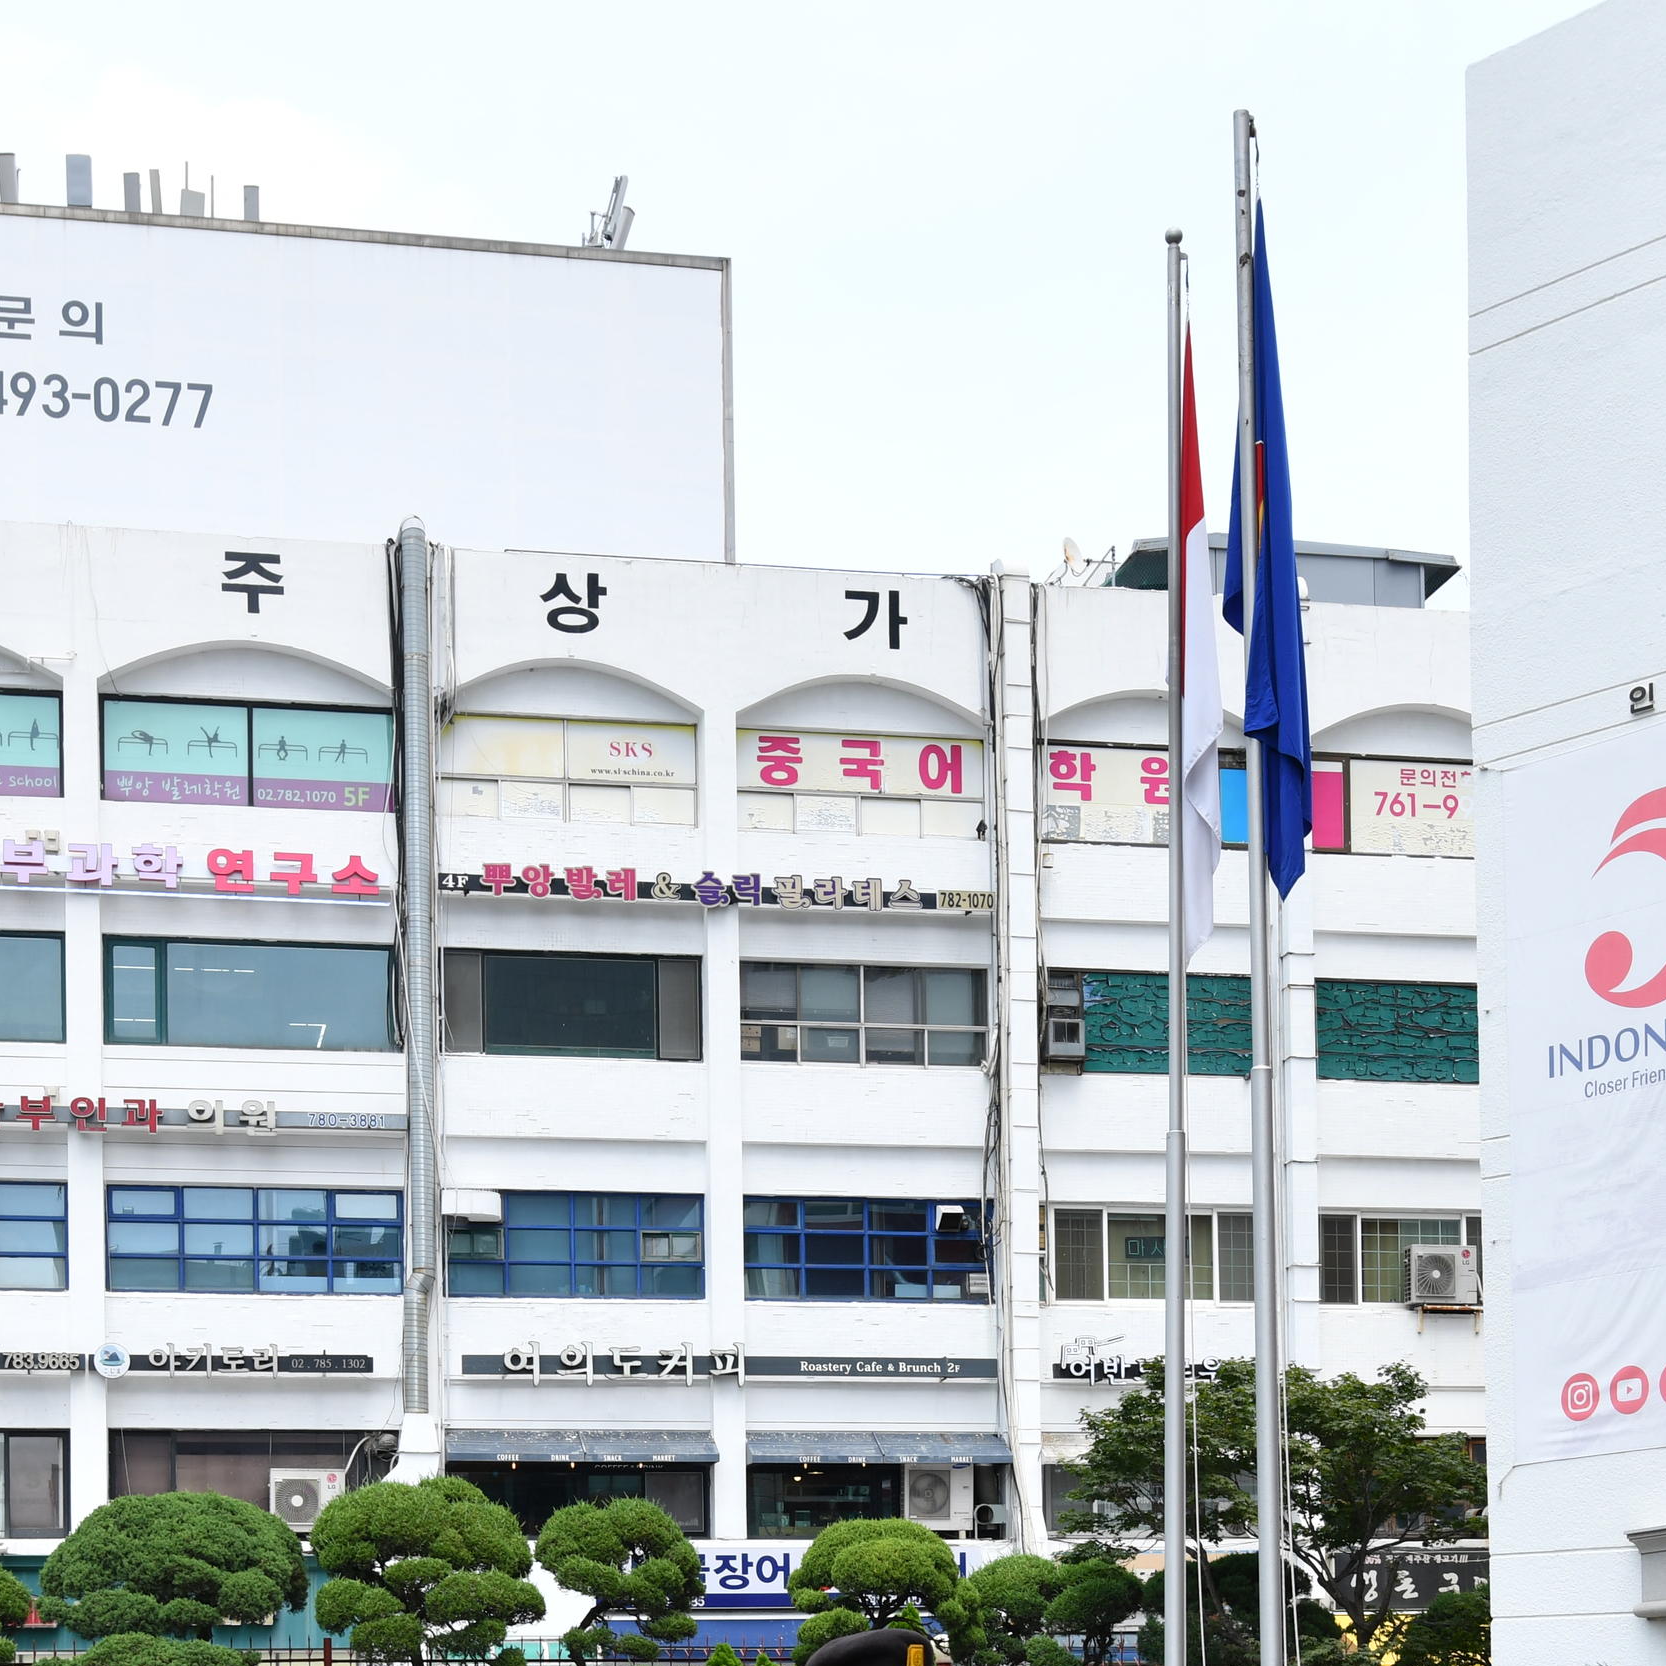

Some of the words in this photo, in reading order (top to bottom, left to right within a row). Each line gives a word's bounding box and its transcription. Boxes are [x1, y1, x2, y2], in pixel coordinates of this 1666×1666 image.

[609, 741, 653, 758] SKS
[757, 736, 963, 795] 중국어
[8, 771, 59, 789] school
[116, 775, 152, 797] 뿌앙
[163, 778, 242, 801] 발레학원
[256, 787, 337, 804] 02.782.1070
[343, 785, 371, 808] 5F
[1374, 791, 1472, 819] 761-9
[206, 848, 380, 896] 연구소
[441, 874, 469, 891] 4F
[479, 863, 639, 902] 뿌앙발레
[653, 872, 683, 900] &
[693, 871, 762, 909] 슬릭
[774, 875, 923, 912] 필라테스
[939, 891, 995, 910] 782-1070
[1583, 1072, 1629, 1099] Closer
[186, 1099, 278, 1137] 의원
[308, 1112, 386, 1128] 780-3881
[1128, 1239, 1190, 1257] 마사
[3, 1351, 80, 1371] 783.9665
[148, 1342, 279, 1379] 야키토리
[503, 1341, 746, 1387] 여의도커피
[800, 1361, 852, 1376] Roastery
[857, 1360, 883, 1373] Cafe
[887, 1364, 895, 1372] &
[898, 1362, 941, 1374] Brunch
[947, 1363, 961, 1374] 2F
[652, 1454, 676, 1462] MARKET
